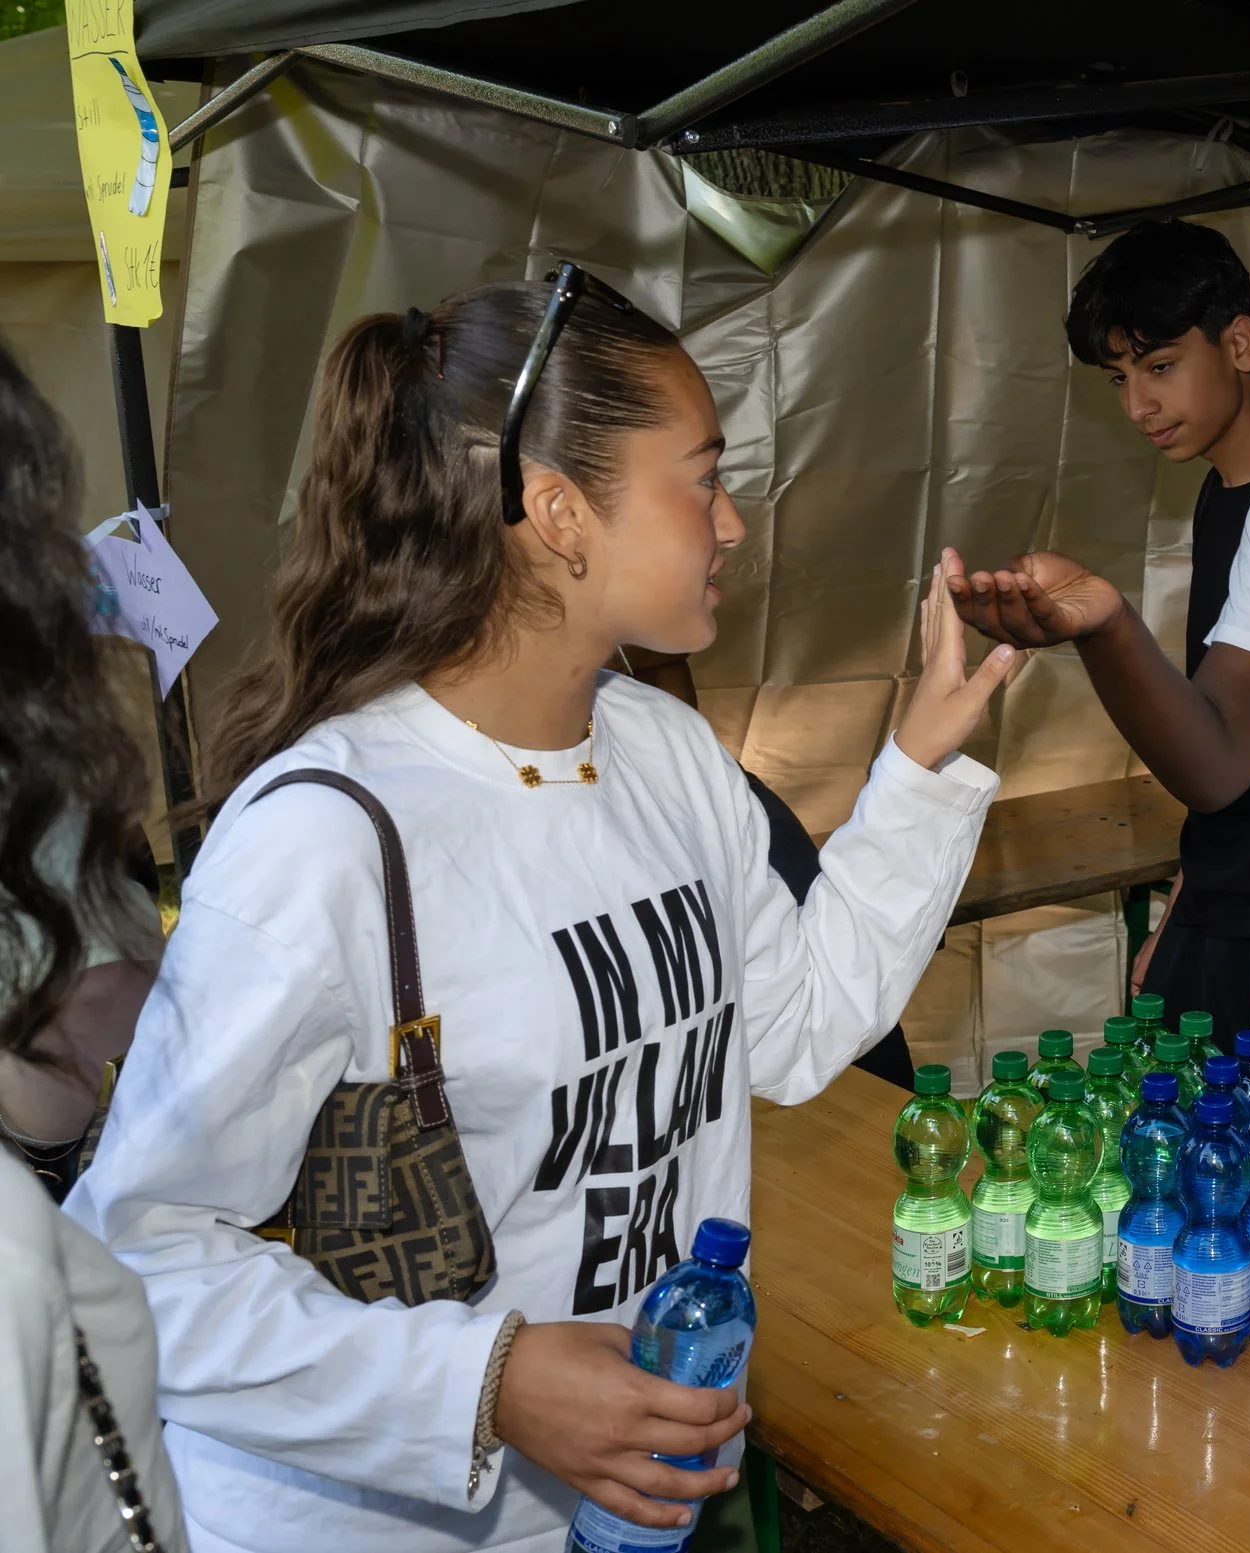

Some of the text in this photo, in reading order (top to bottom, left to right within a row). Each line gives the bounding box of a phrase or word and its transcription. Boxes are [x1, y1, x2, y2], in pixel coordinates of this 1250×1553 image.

[97, 171, 126, 203] Sprudel
[121, 550, 161, 594] Wasser
[551, 880, 722, 1062] IN MY
[533, 1002, 735, 1192] VILLAIN
[572, 1155, 681, 1316] ERA
